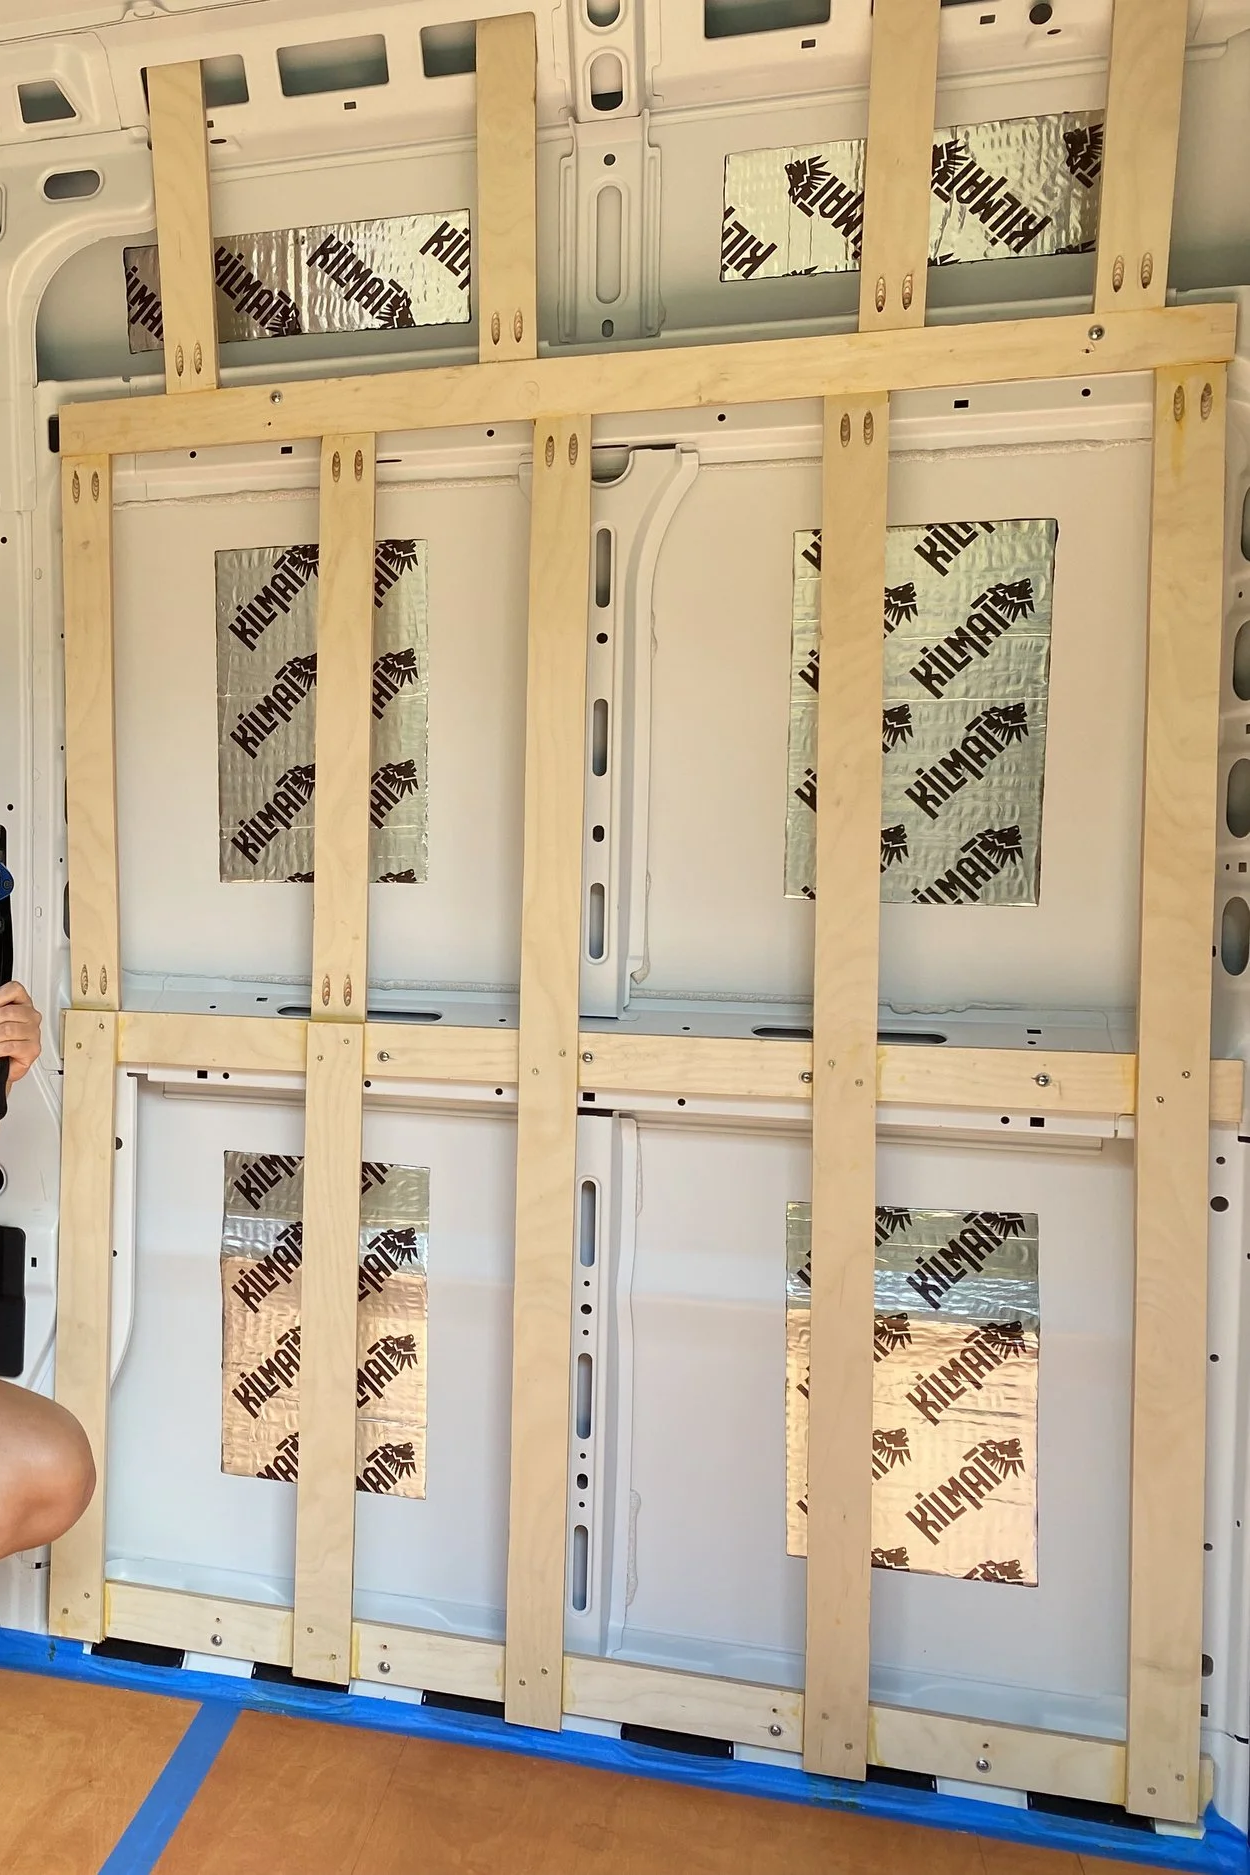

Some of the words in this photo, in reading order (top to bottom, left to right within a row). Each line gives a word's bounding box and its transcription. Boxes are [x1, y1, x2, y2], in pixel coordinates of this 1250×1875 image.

[721, 206, 778, 279] KIL
[797, 175, 864, 260] MAT
[228, 555, 307, 652] KILMAT
[909, 593, 1013, 700] KILMAT
[230, 666, 308, 760] KILMAT
[904, 716, 1007, 821] KILMAT
[230, 774, 308, 866] KILMAT
[906, 1212, 999, 1311] KILMAT
[906, 1329, 1004, 1427] KILMAT
[905, 1443, 1002, 1546] KILMAT
